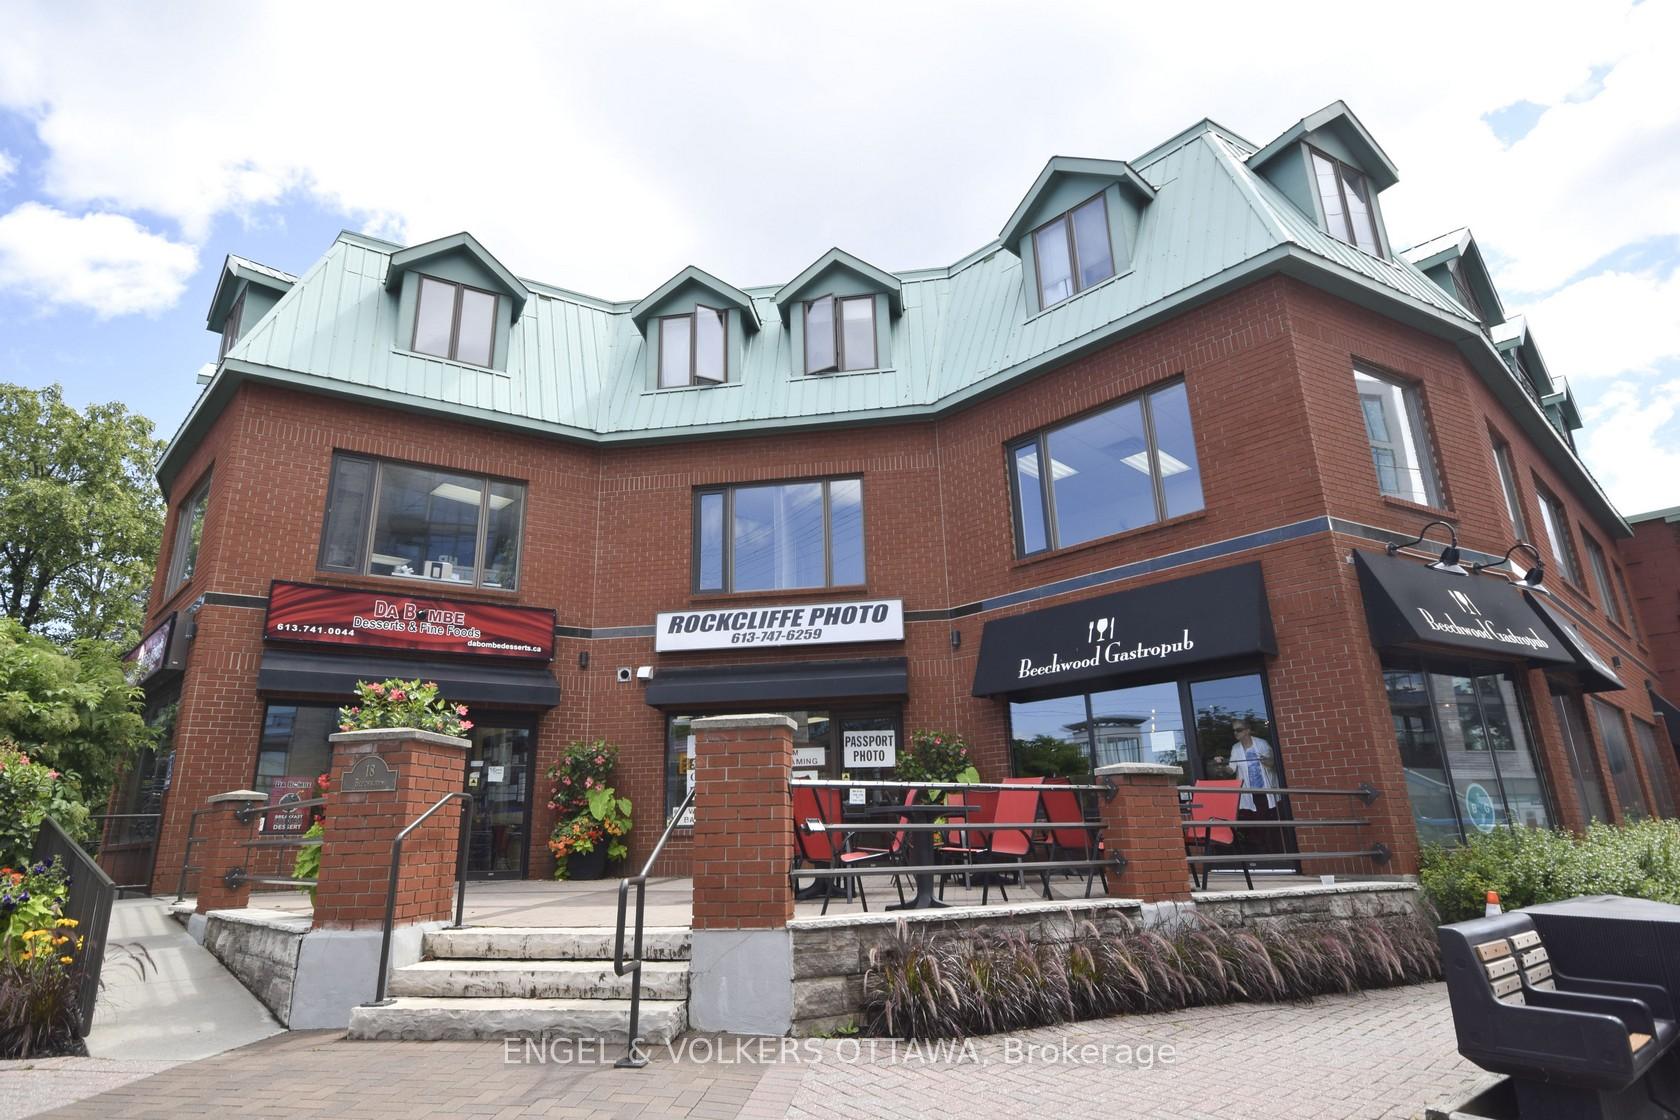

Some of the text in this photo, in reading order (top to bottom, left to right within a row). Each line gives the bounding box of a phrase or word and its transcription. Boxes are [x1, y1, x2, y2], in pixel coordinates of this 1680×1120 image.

[668, 603, 889, 634] ROCKCLIFFE PHOTO
[277, 623, 355, 636] 613.741.0044
[353, 616, 480, 638] Desserts & Fine Foods
[1417, 607, 1549, 650] Beechwood Gastropub
[731, 628, 822, 644] 613-747-6259
[467, 640, 541, 653] dabombedesserts.ca
[1018, 629, 1194, 679] Beechwood Gastropub
[845, 735, 894, 748] PASSPORT
[853, 749, 885, 762] PHOTO
[366, 764, 375, 777] 18
